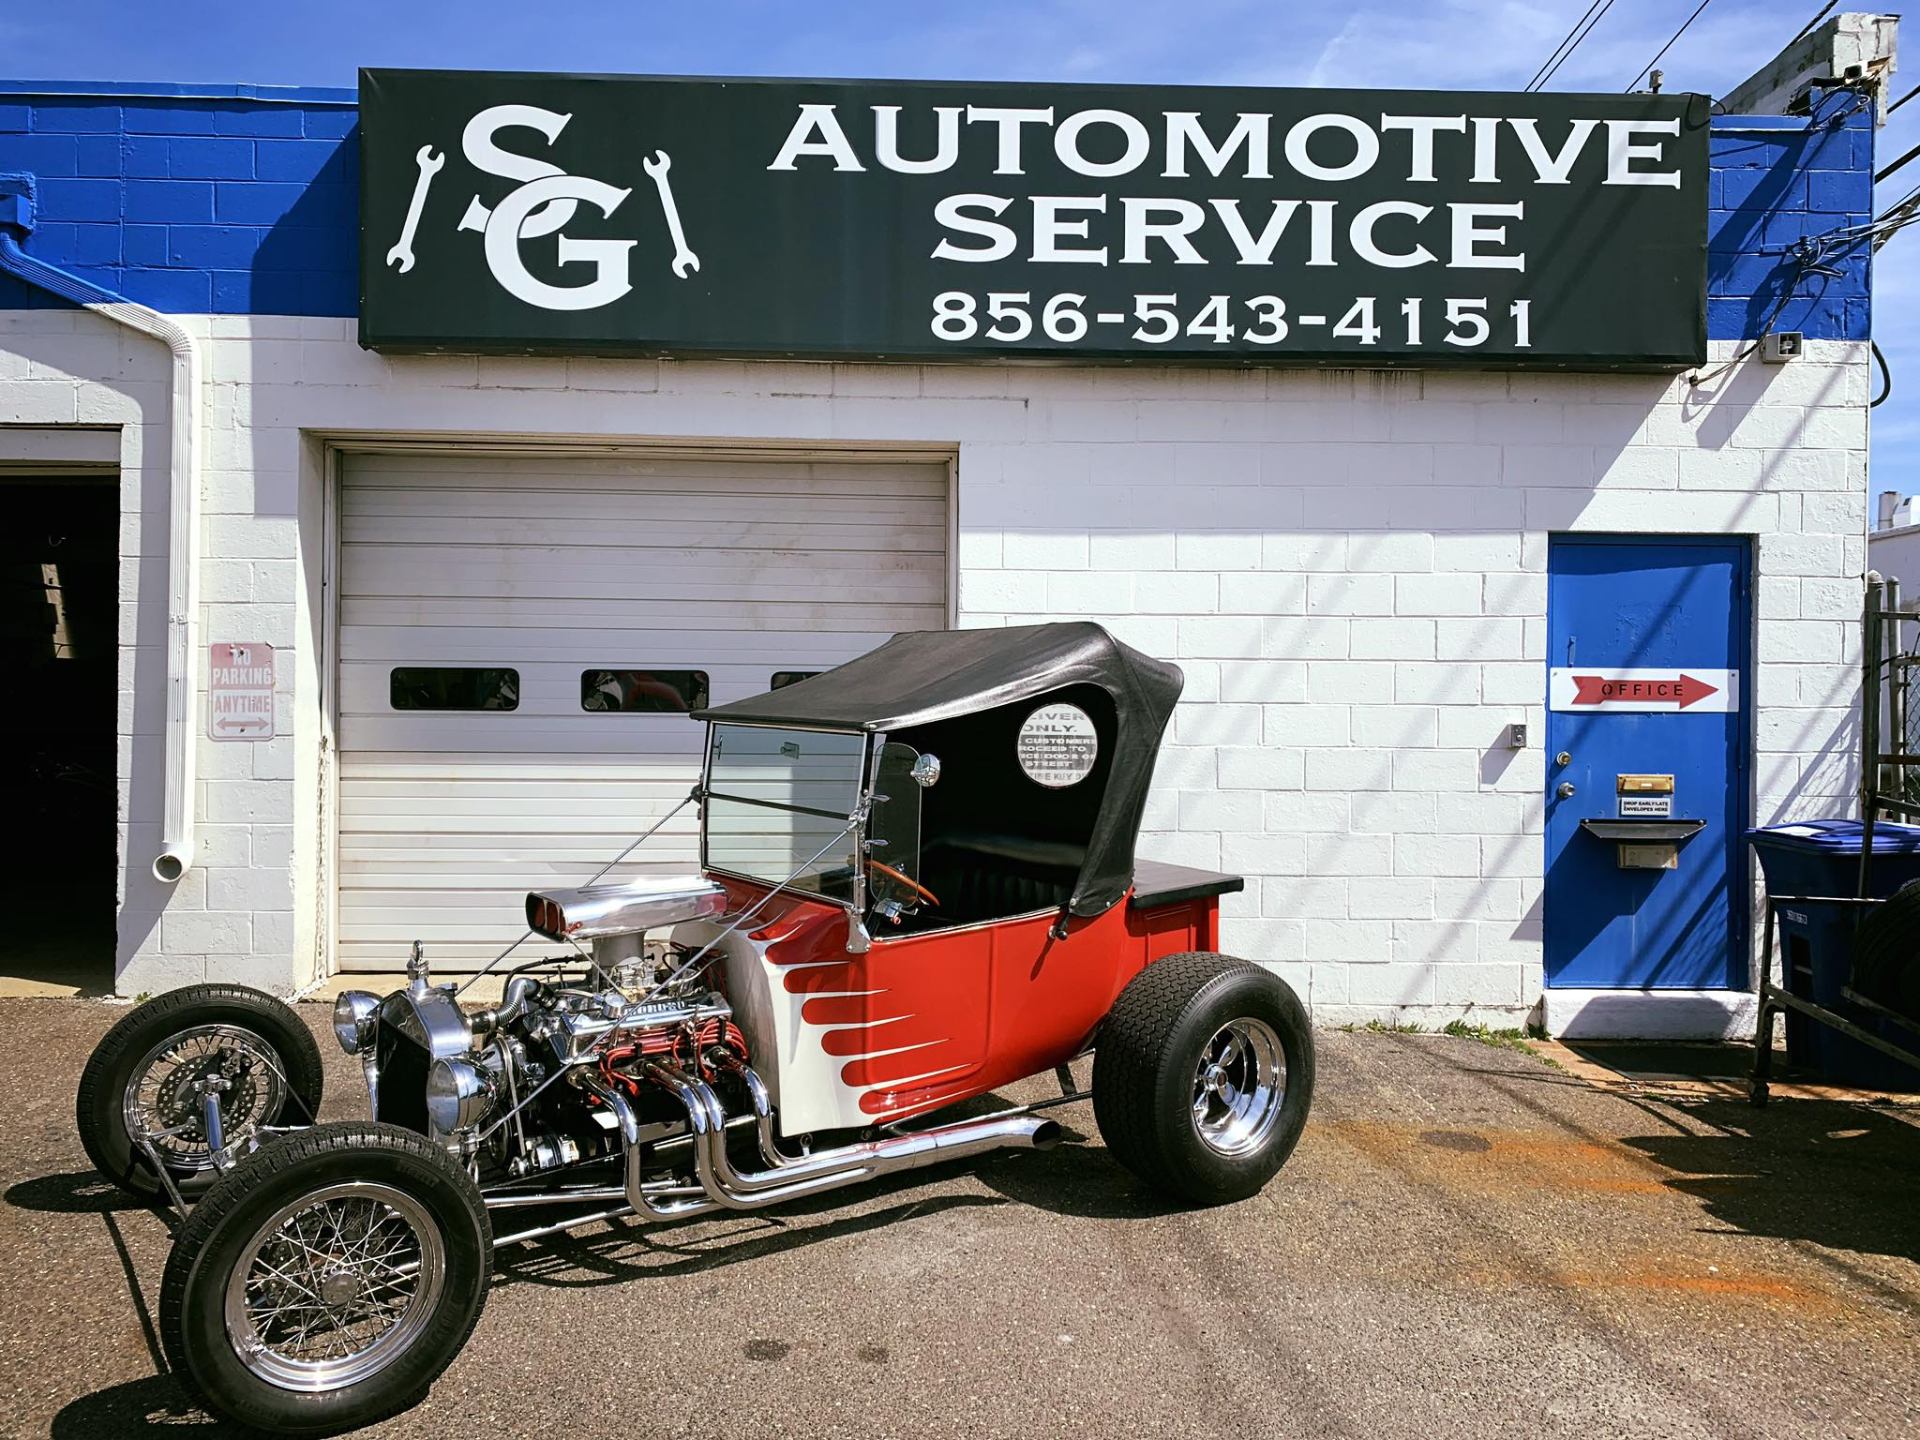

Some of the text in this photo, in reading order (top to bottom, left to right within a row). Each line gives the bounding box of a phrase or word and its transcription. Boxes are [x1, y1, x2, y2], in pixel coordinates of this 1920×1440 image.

[766, 103, 1681, 190] AUTOMOTIVE
[930, 193, 1526, 273] SERVICE
[930, 290, 1532, 348] 856-543-4151
[232, 648, 251, 666] NO
[212, 667, 272, 685] PARKING
[1601, 683, 1683, 696] OFFICE
[214, 695, 270, 713] ANYTIME
